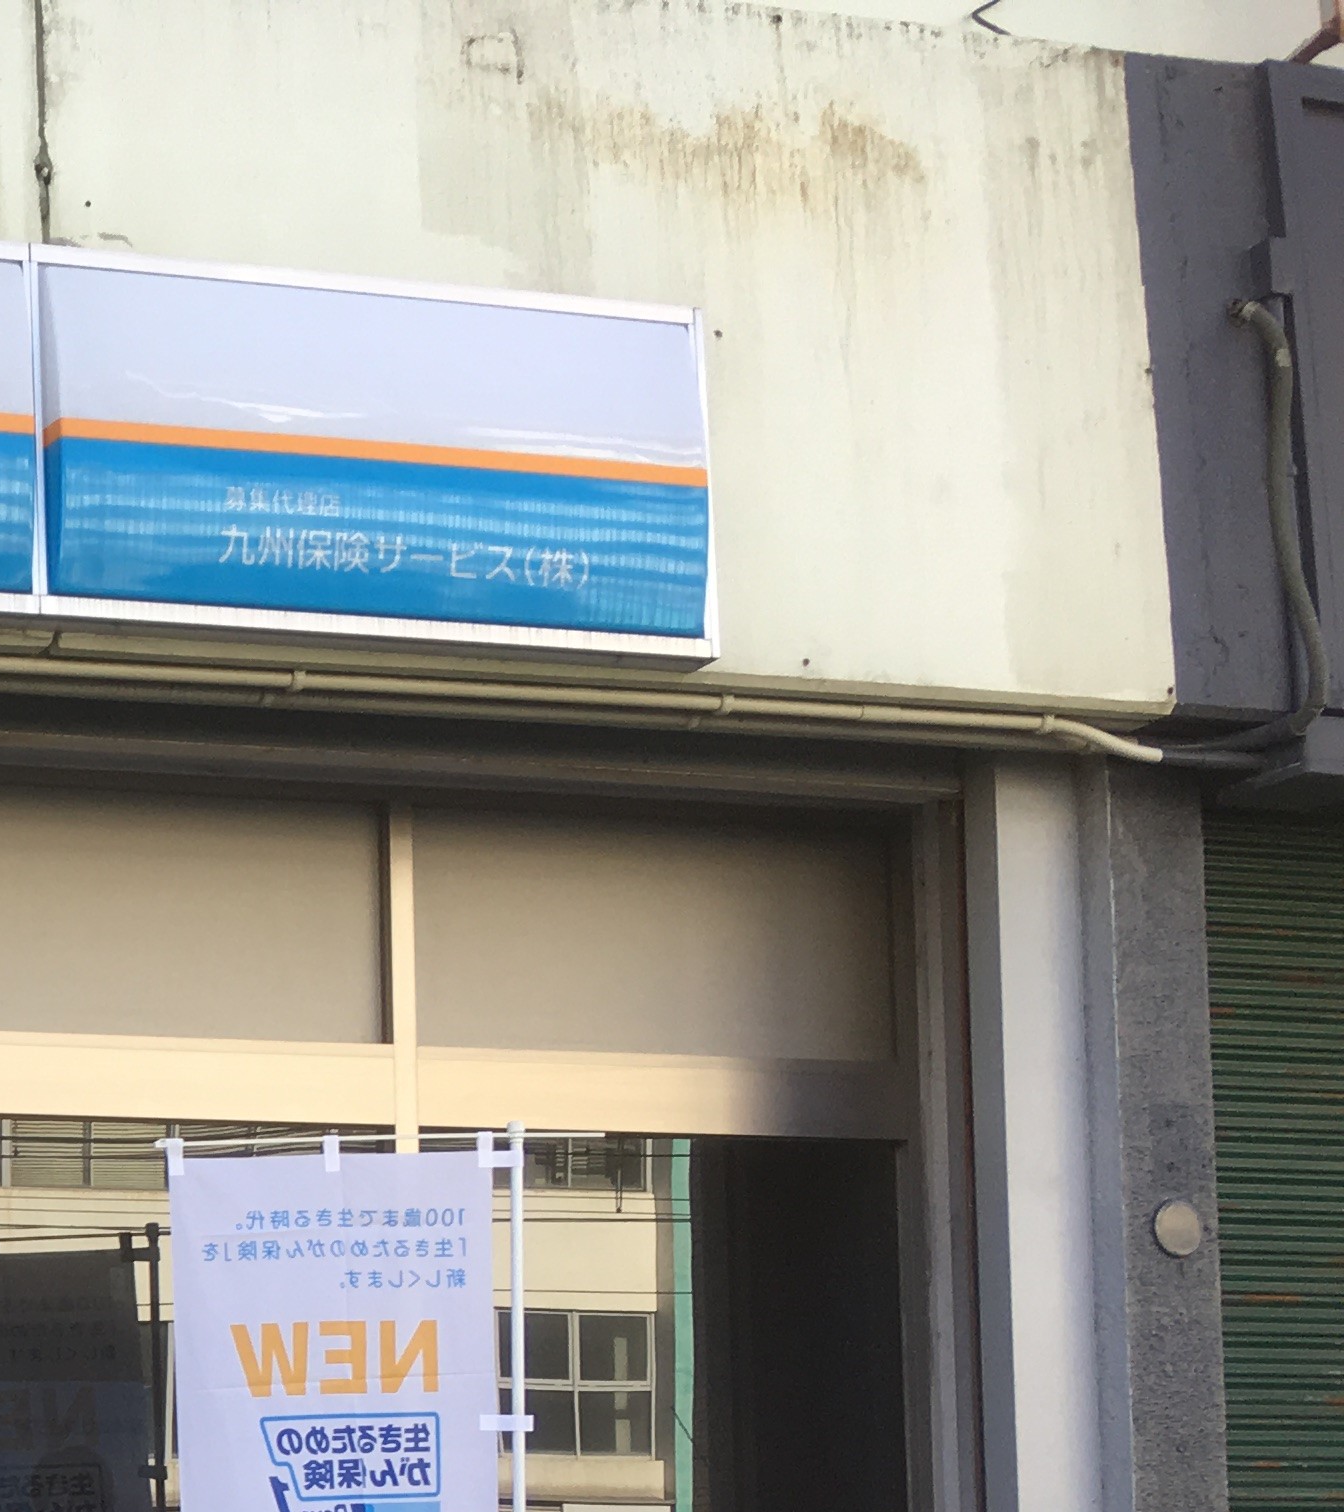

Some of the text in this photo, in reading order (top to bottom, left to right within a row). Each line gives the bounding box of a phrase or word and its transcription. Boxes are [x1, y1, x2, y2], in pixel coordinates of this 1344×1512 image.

[225, 486, 341, 518] 募集代理店
[218, 524, 591, 588] 九州保険サービス(株)
